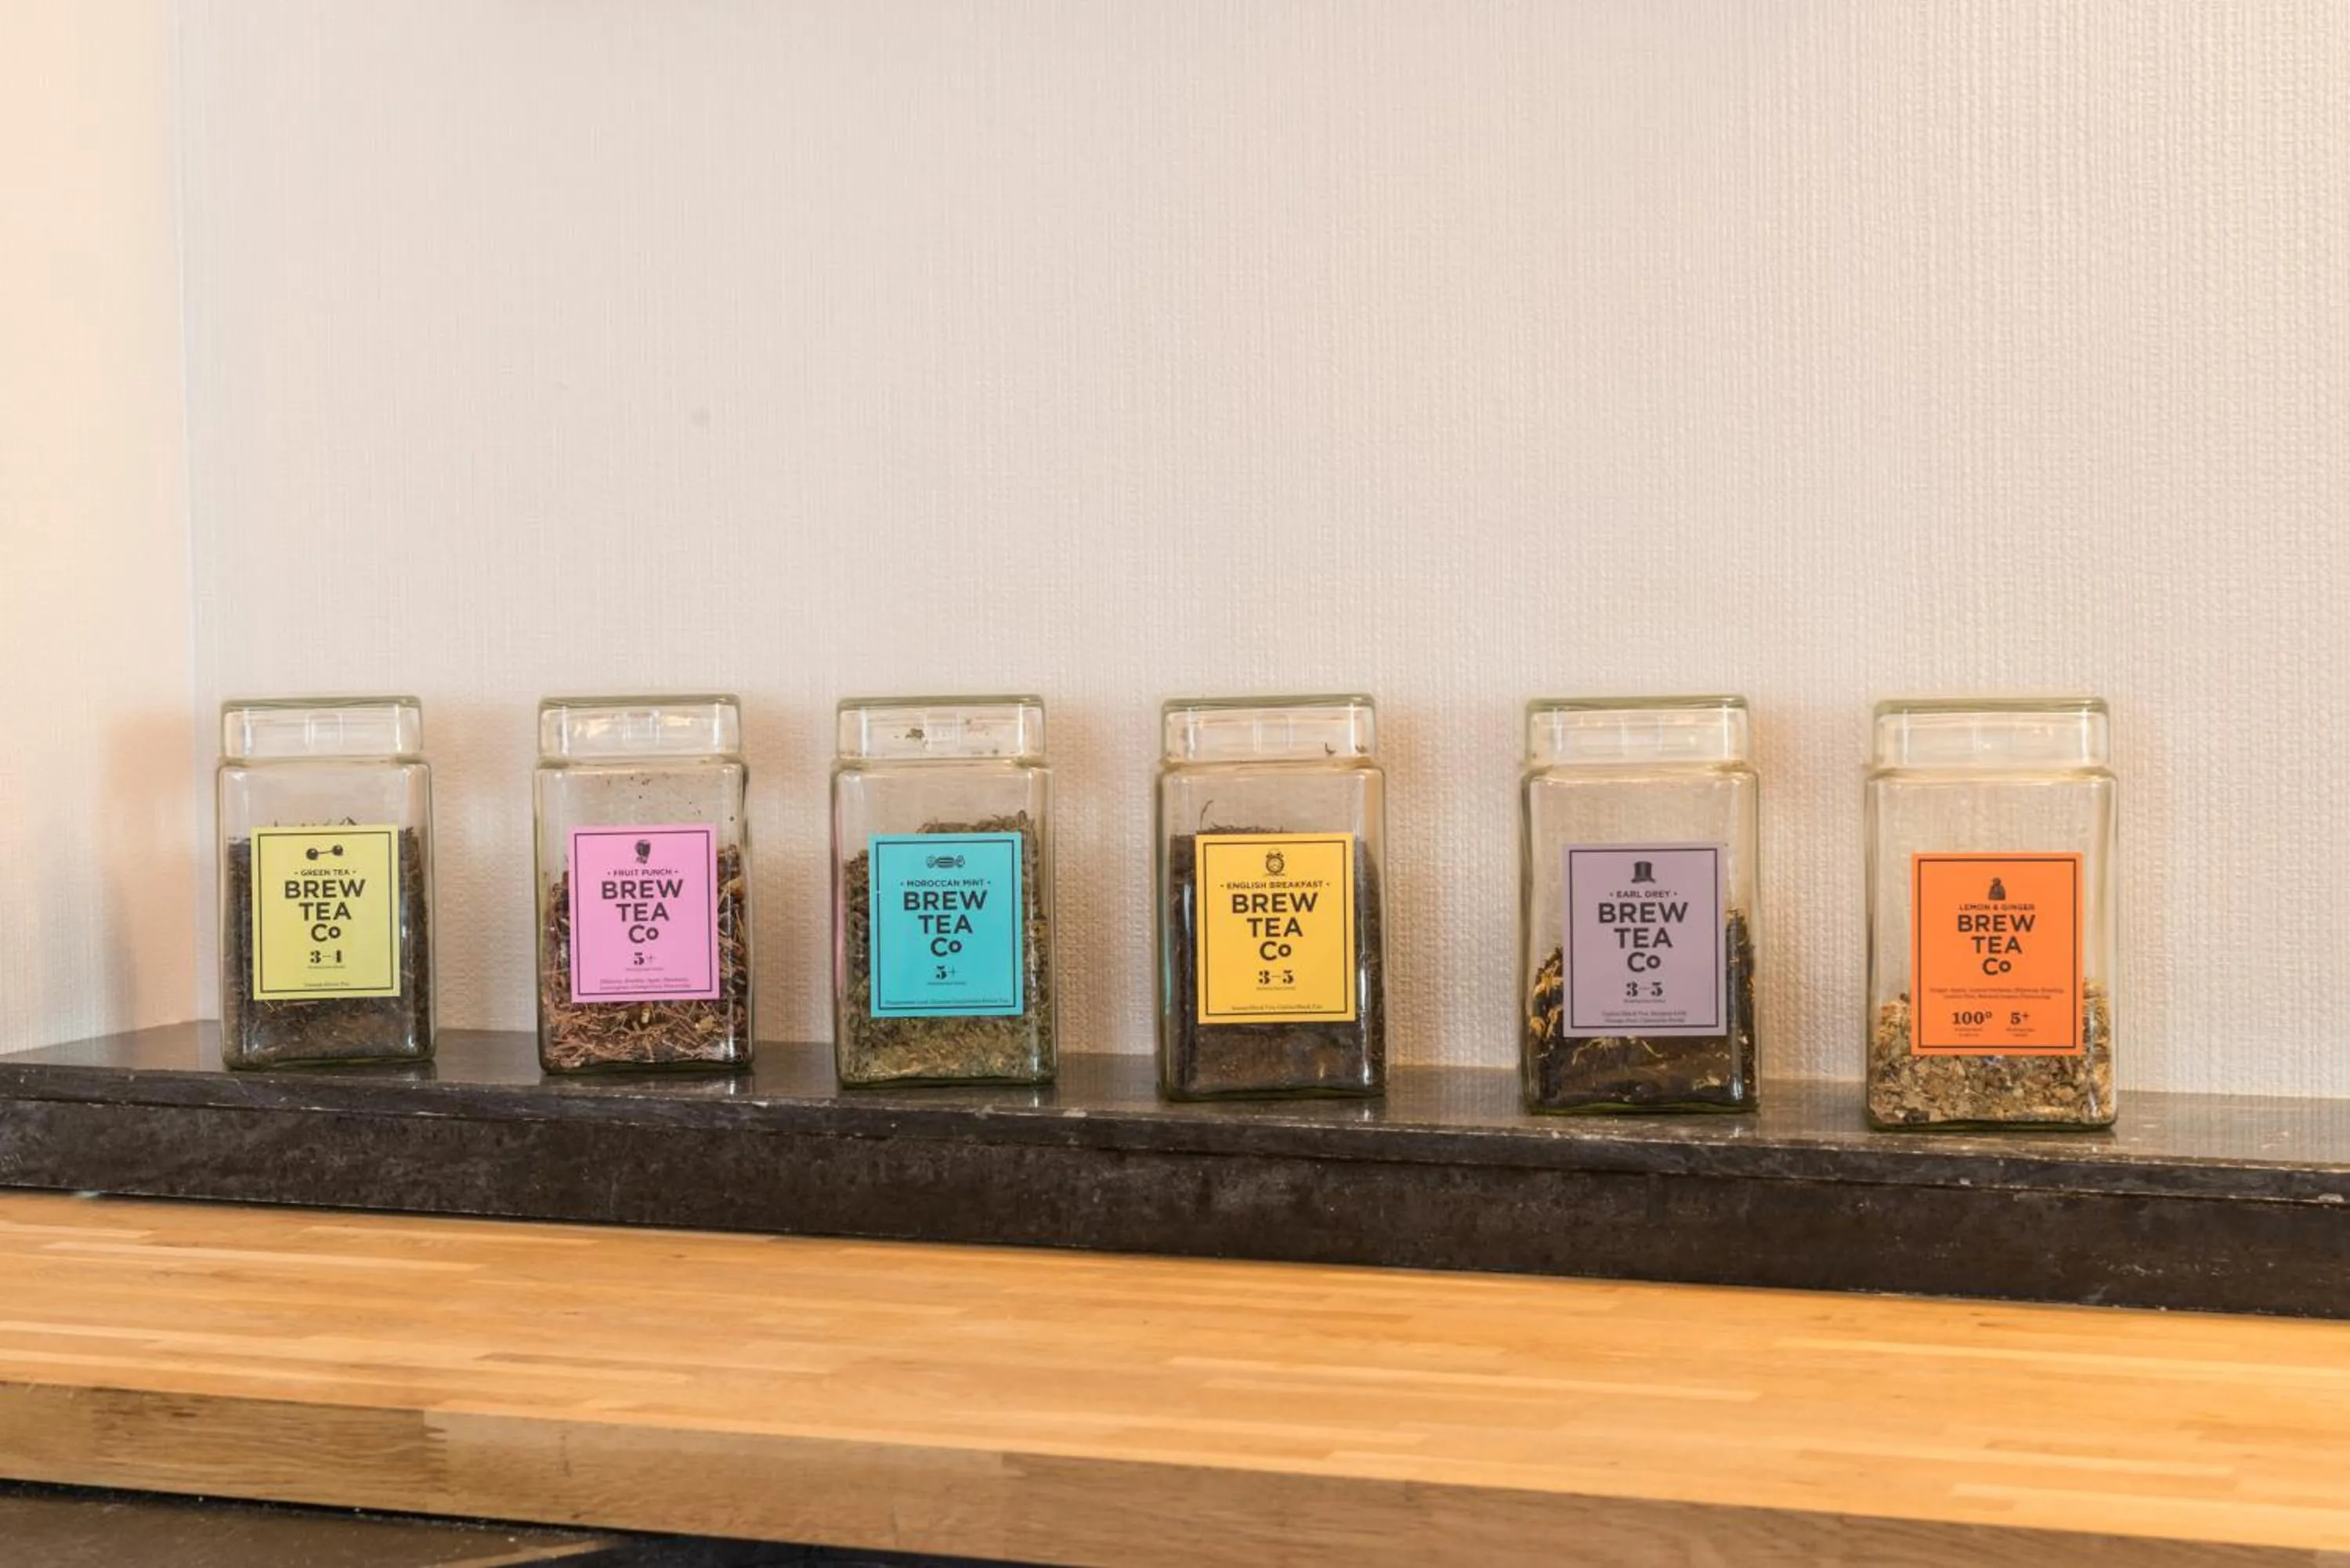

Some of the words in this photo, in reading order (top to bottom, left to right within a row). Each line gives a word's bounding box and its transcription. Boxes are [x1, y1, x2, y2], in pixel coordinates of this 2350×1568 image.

[284, 879, 366, 899] BREW
[601, 879, 683, 900] BREW
[1269, 880, 1323, 889] BREAKFAST
[1645, 890, 1670, 898] GREY
[903, 890, 987, 911] BREW
[1231, 892, 1318, 914] BREW
[298, 901, 352, 921] TEA
[616, 902, 670, 922] TEA
[1598, 901, 1689, 923] BREW
[311, 923, 341, 942] Co
[917, 914, 973, 934] TEA
[1246, 917, 1303, 938] TEA
[1958, 915, 2036, 932] BREW
[628, 924, 660, 944] Co
[1614, 927, 1673, 948] TEA
[930, 937, 963, 957] Co
[1259, 941, 1292, 961] Co
[1972, 937, 2023, 954] TEA
[1627, 952, 1661, 973] Co
[1982, 958, 2012, 975] Co
